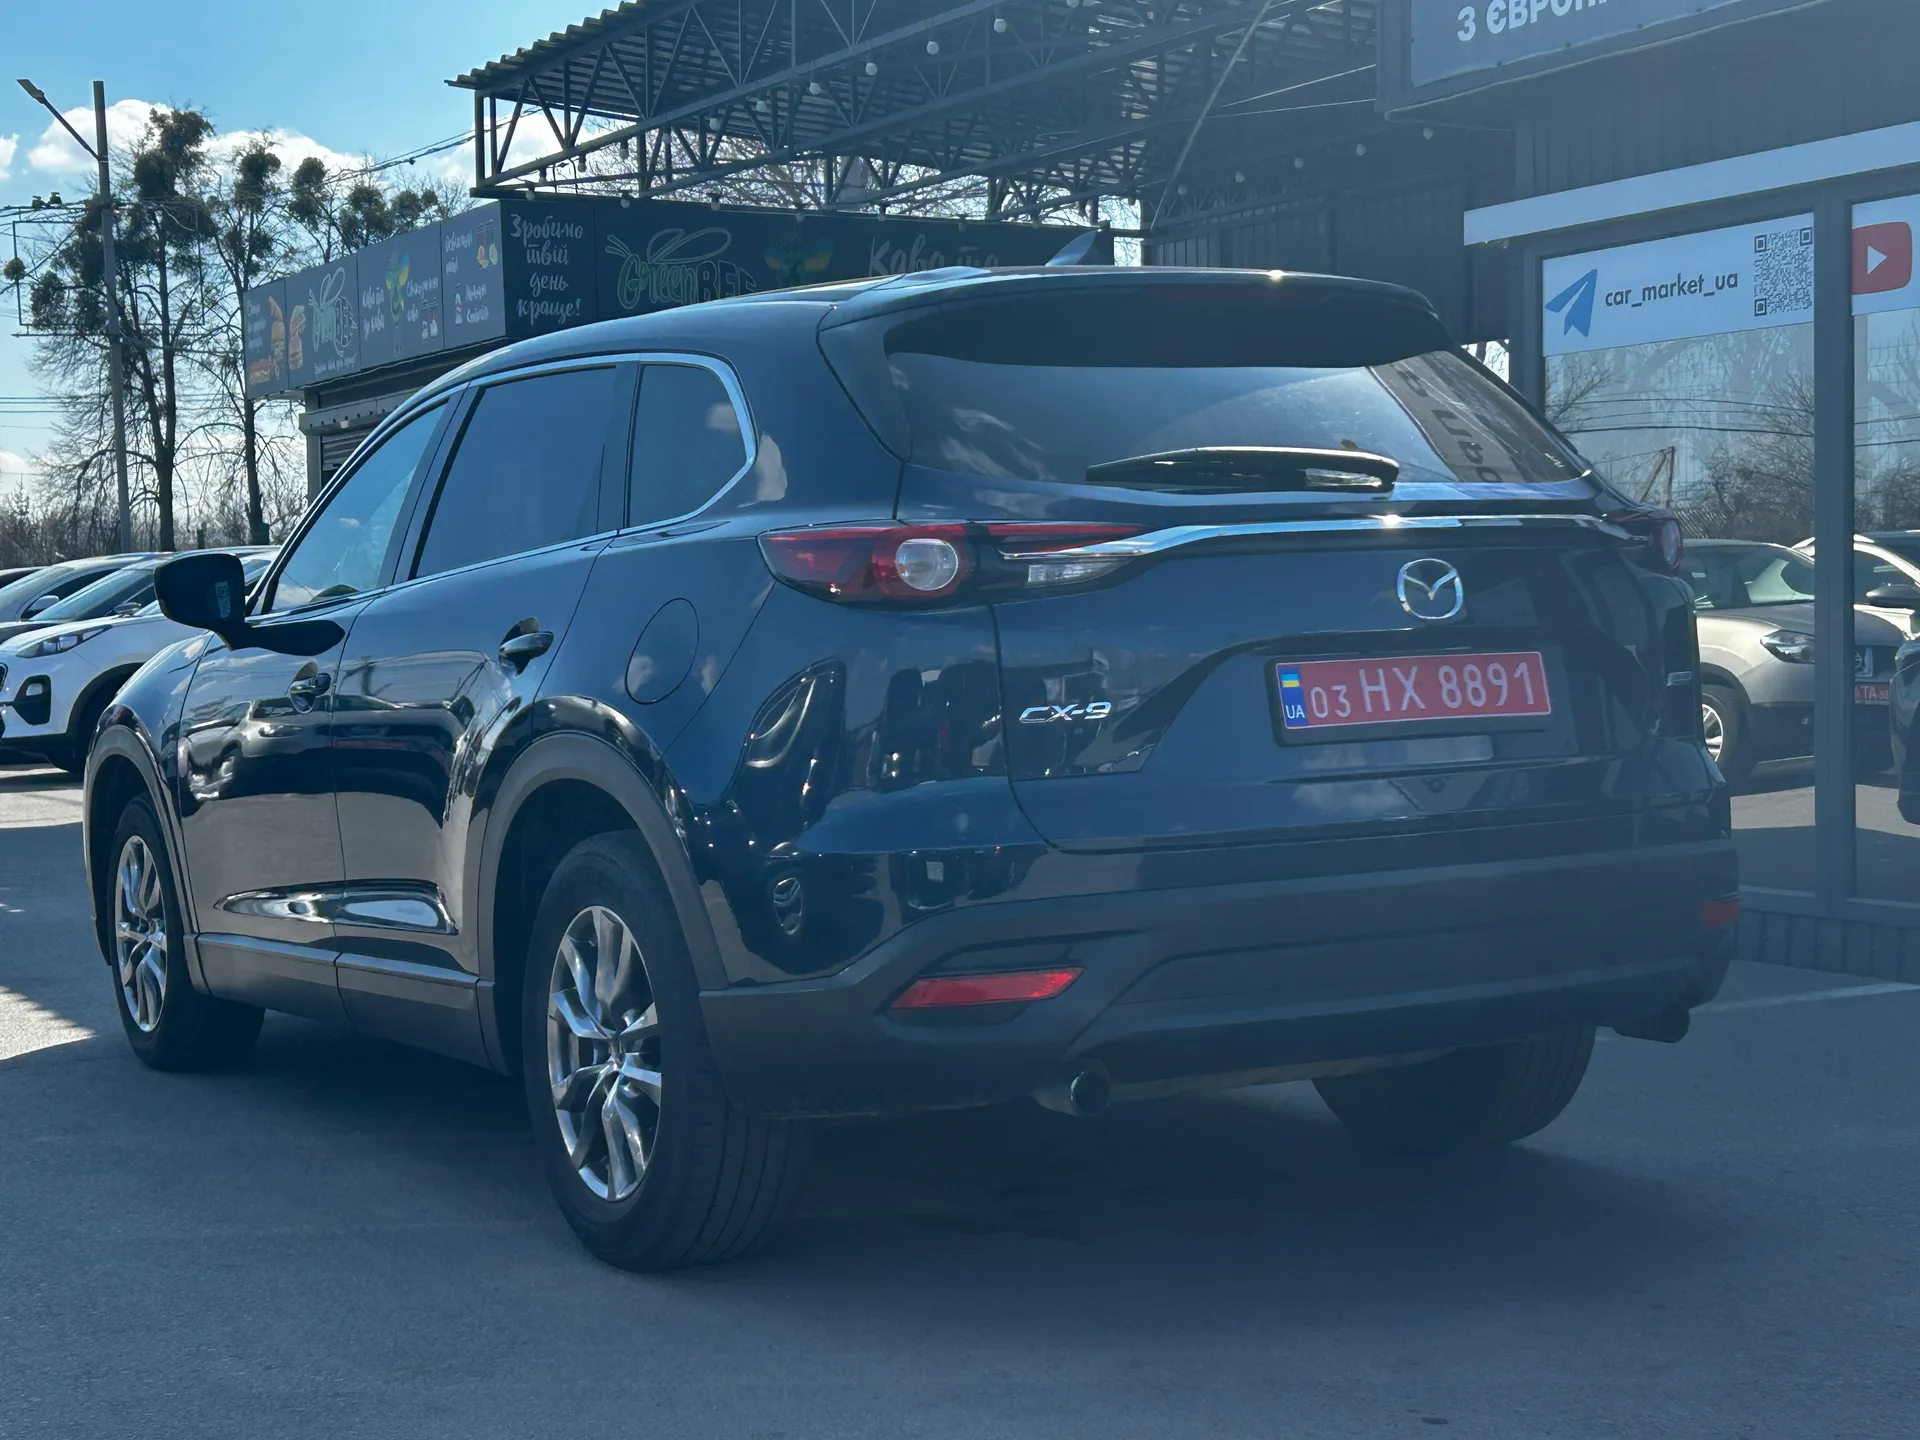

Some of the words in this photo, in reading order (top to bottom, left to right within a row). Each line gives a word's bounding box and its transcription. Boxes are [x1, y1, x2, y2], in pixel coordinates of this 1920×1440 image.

[1457, 6, 1476, 42] З
[510, 213, 584, 247] Зробимо
[526, 239, 569, 266] твій
[529, 272, 569, 297] день
[1604, 272, 1739, 308] car_market_ua
[516, 298, 582, 326] краще!
[1309, 685, 1351, 719] 03
[1438, 661, 1535, 709] 8891
[1019, 701, 1112, 724] CX-9
[1285, 704, 1306, 720] UA
